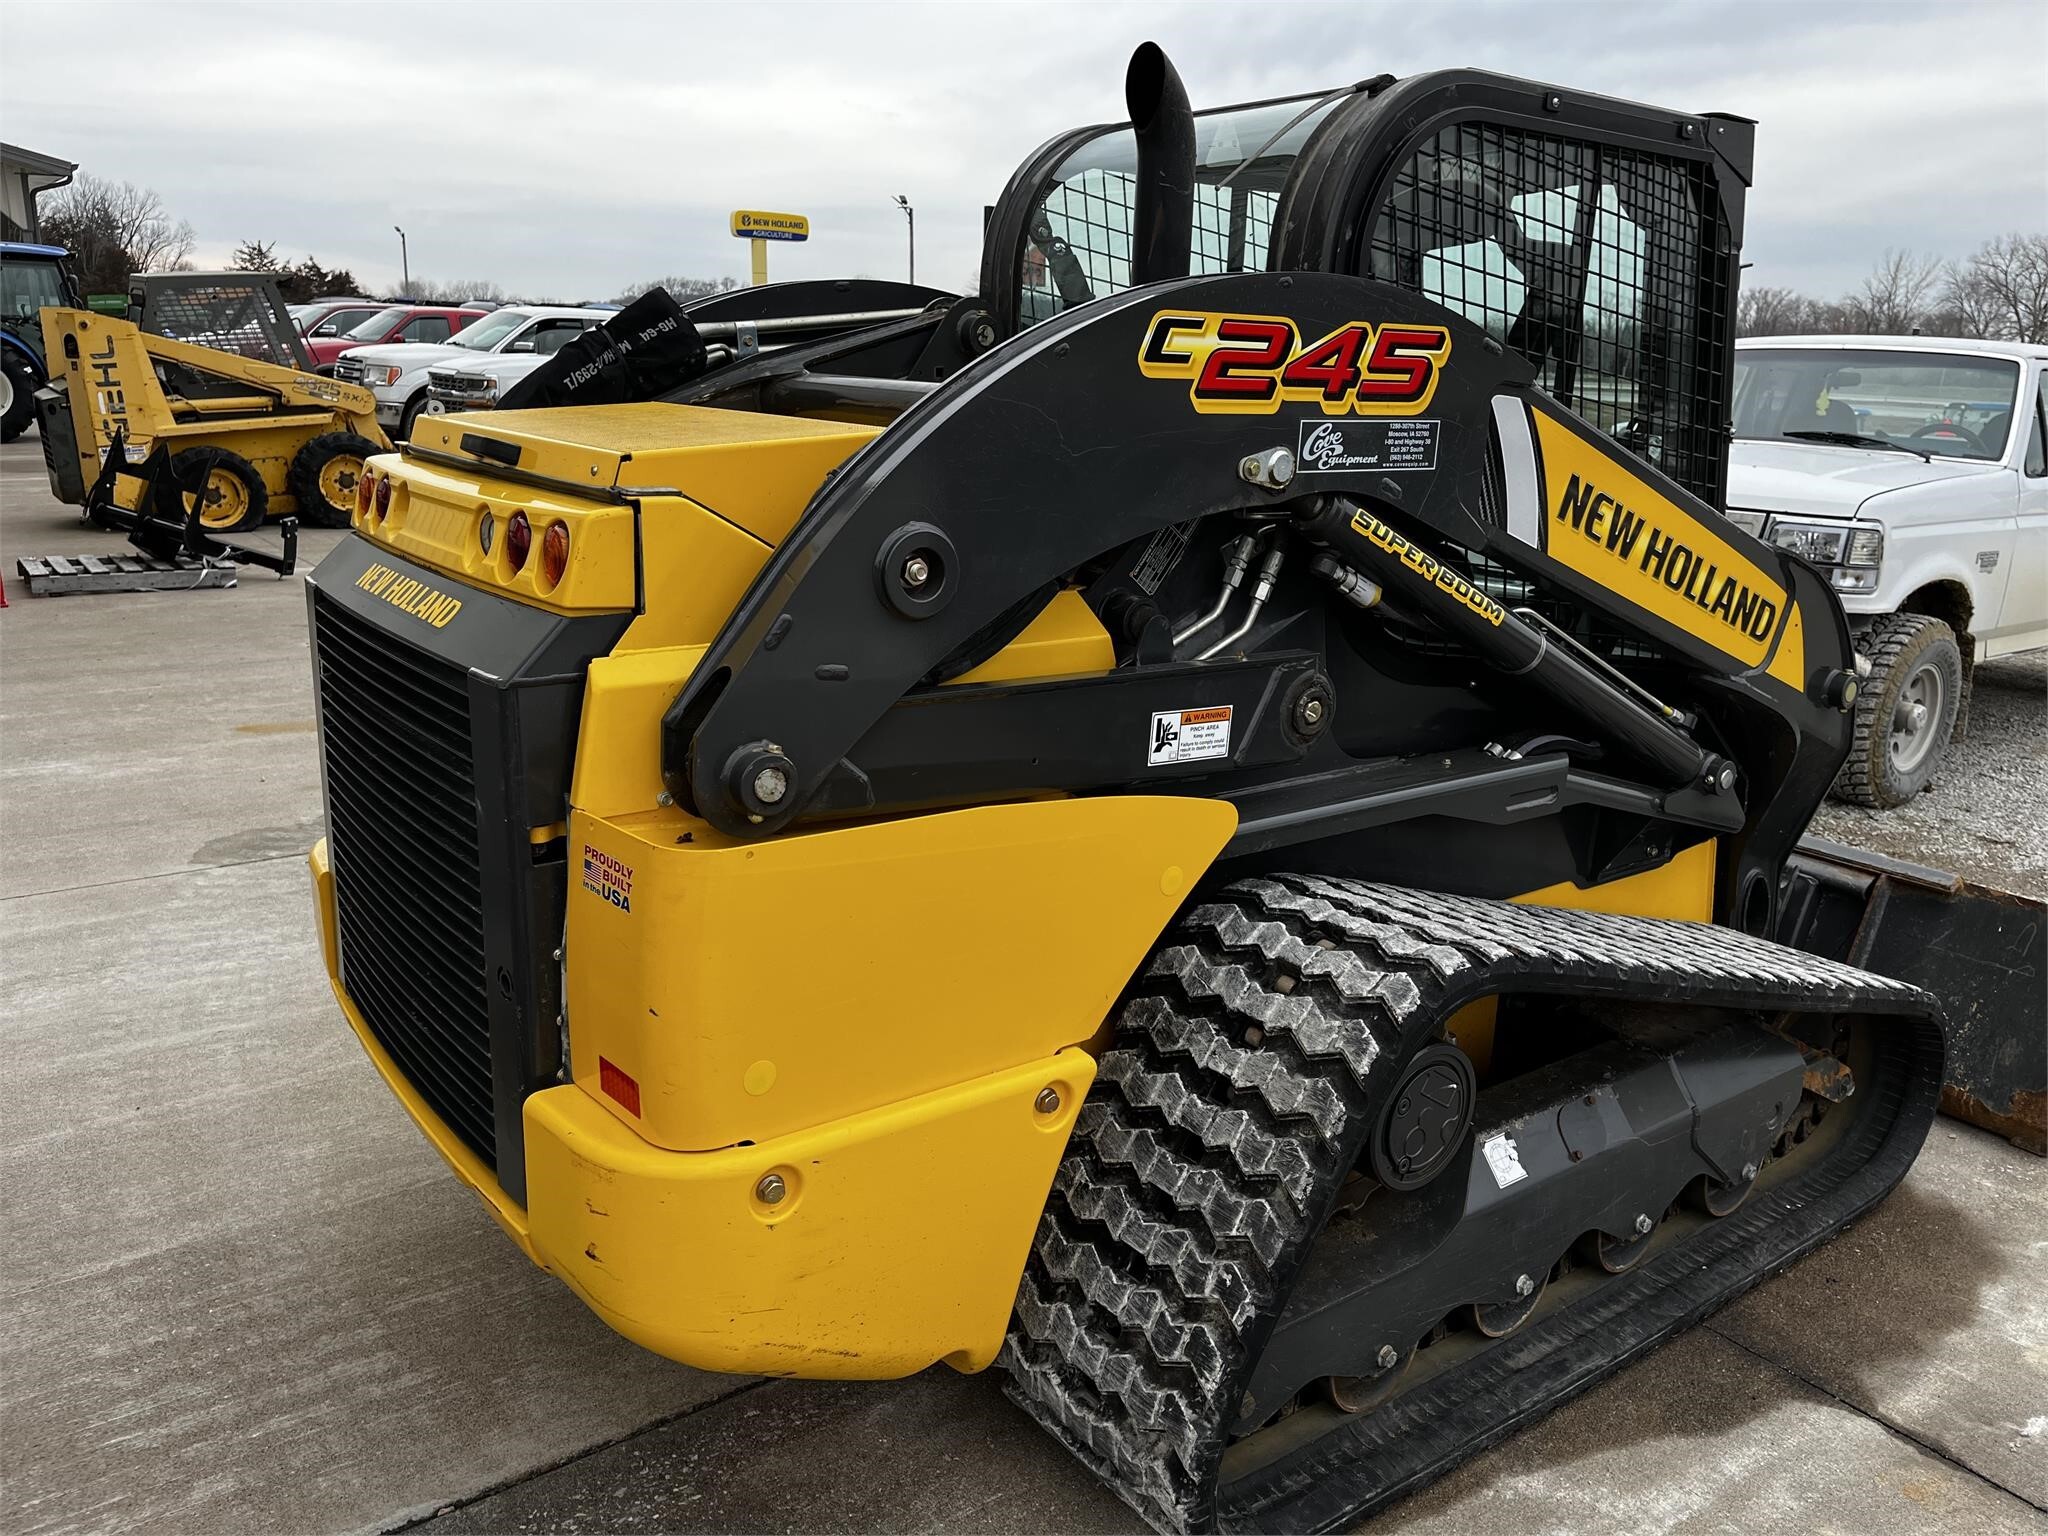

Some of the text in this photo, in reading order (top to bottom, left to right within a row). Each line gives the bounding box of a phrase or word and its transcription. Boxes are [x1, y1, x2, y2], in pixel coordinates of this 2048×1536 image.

[752, 230, 793, 239] AGRICULTURE
[753, 218, 804, 229] NEW HOLLAND
[1140, 312, 1451, 410] C245
[1415, 422, 1430, 430] Street
[1302, 422, 1344, 461] Cove
[1404, 438, 1425, 446] Highway
[1318, 450, 1379, 470] Equipment
[1351, 508, 1505, 627] SUPER BOOM
[1556, 472, 1778, 645] NEW HOLLAND
[354, 562, 463, 629] NEW HOLLAND
[1193, 710, 1228, 721] WARNING
[584, 844, 634, 880] PROUDLY
[602, 868, 633, 895] BUILT
[589, 884, 601, 896] the
[601, 883, 631, 914] USA
